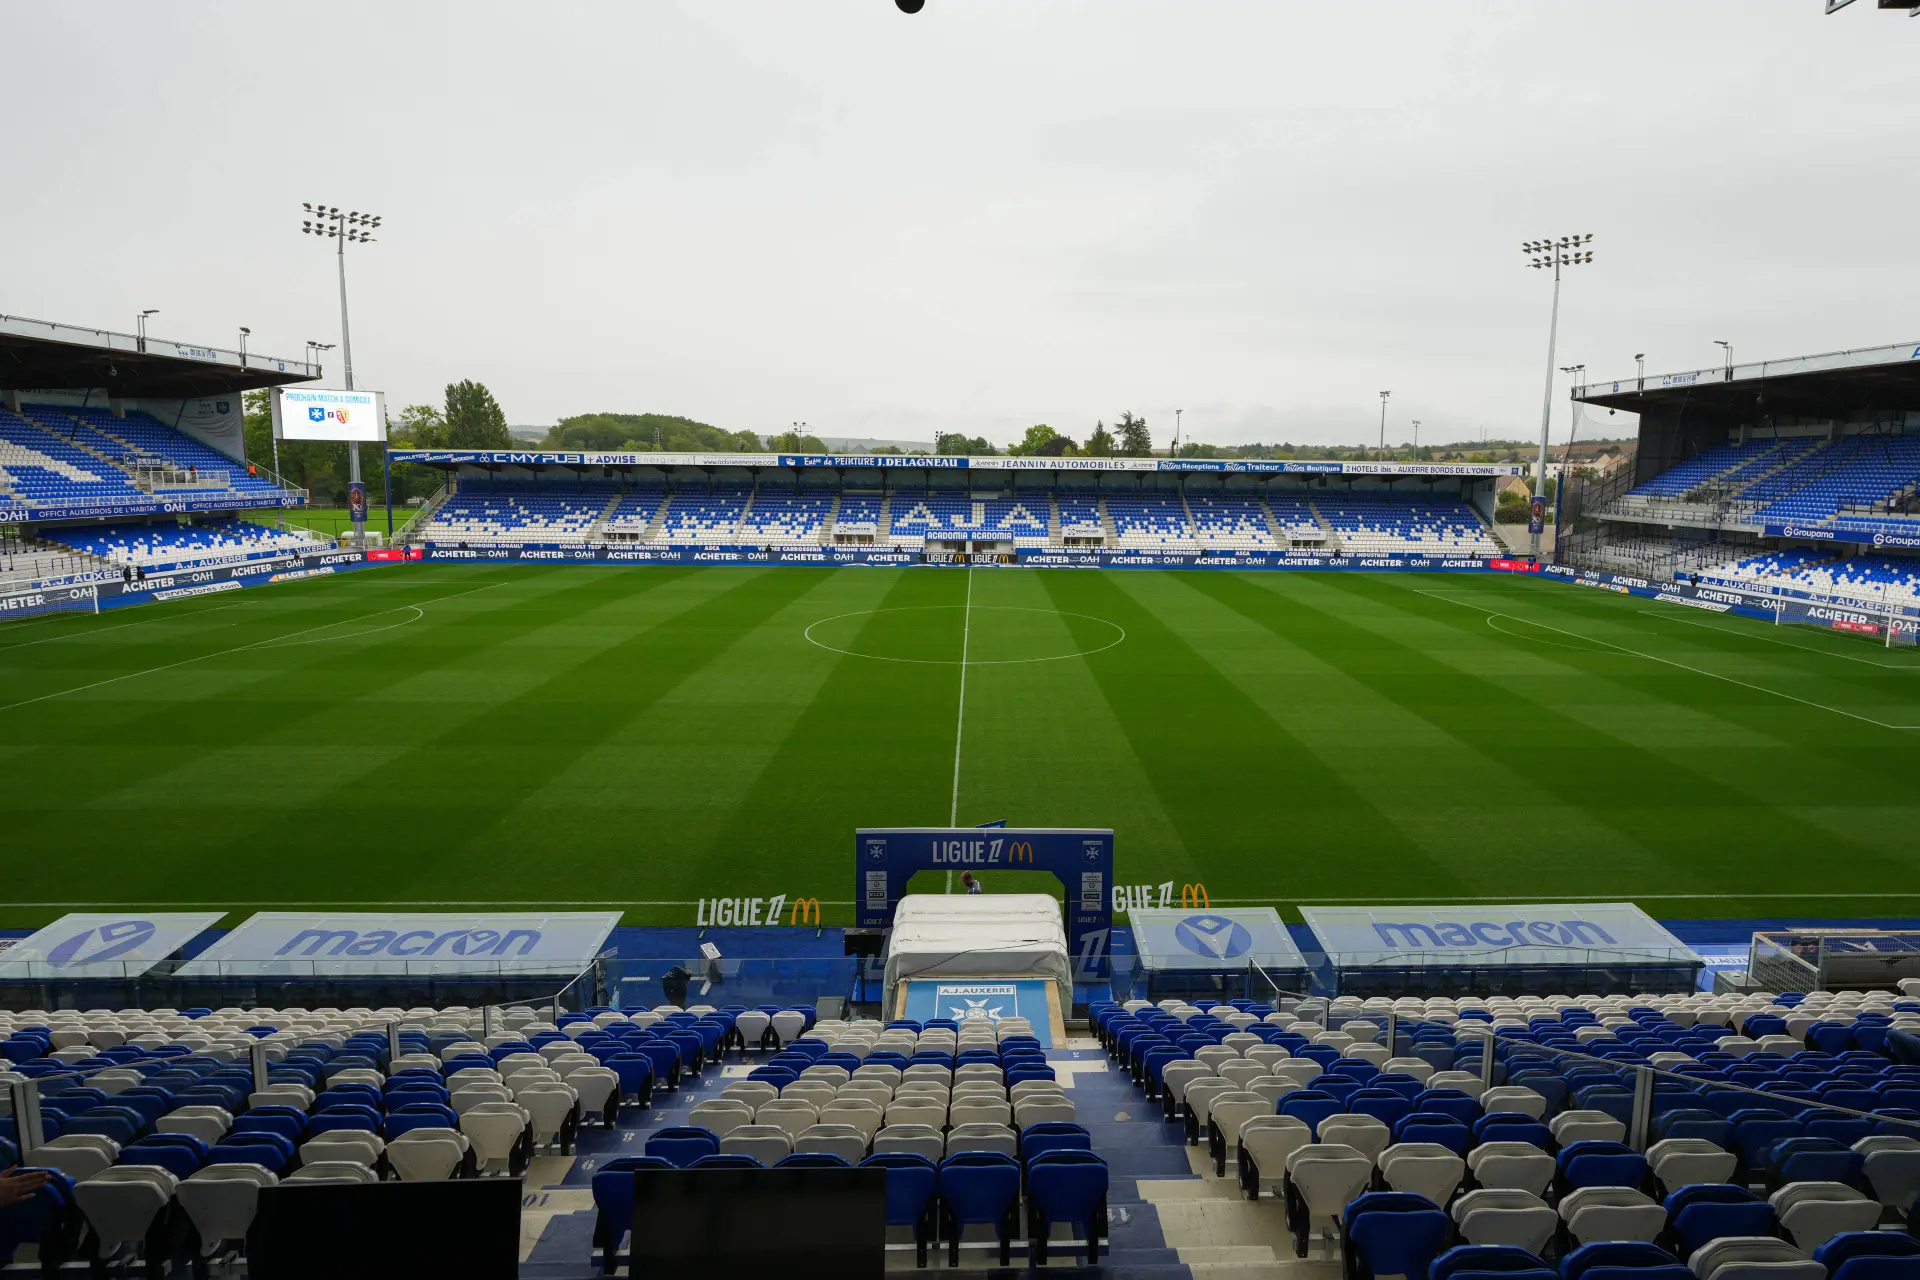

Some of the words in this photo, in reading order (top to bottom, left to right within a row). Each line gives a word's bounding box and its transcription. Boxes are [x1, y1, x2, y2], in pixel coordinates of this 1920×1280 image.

[286, 392, 316, 402] PROCHAIN
[318, 394, 338, 402] MATCH
[596, 456, 636, 464] ADVISE
[835, 458, 876, 466] PEINTURE
[1002, 460, 1046, 468] JEANNIN
[1050, 460, 1126, 469] AUTOMOBILES
[1246, 463, 1279, 471] Traiteur
[1306, 464, 1340, 473] Boutiques
[164, 502, 187, 512] OAH
[214, 500, 244, 508] AUXERROIS
[282, 497, 298, 506] OAH
[0, 510, 29, 522] OAH
[38, 510, 67, 518] OFFICE
[70, 508, 112, 516] AUXERROIS
[125, 506, 157, 514] L'HABITAT
[928, 532, 968, 540] ACADOMIA
[972, 532, 1012, 540] ACADOMIA
[1794, 528, 1834, 539] Groupama
[1885, 535, 1920, 546] Groupa
[275, 549, 293, 558] A.J.
[607, 552, 652, 560] ACHETER
[694, 552, 738, 560] ACHETER
[926, 554, 948, 562] LIGUE
[970, 554, 992, 562] LIGUE
[175, 562, 196, 570] A.J.
[200, 554, 248, 567] AUXERRE
[320, 554, 362, 565] ACHETER
[231, 564, 272, 578] ACHETER
[286, 558, 304, 568] OAH
[1545, 564, 1575, 576] ACHETER
[1584, 570, 1600, 580] OAH
[41, 577, 69, 588] A.J.
[122, 578, 175, 594] ACHETER
[192, 571, 214, 582] OAH
[1612, 576, 1648, 588] ACHETER
[1662, 583, 1680, 594] OAH
[1702, 576, 1720, 586] A.J.
[1722, 580, 1773, 594] AUXERRE
[1696, 590, 1742, 604] ACHETER
[1762, 599, 1786, 610] OAH
[1808, 606, 1868, 624] ACHETER
[932, 840, 986, 863] LIGUE
[697, 898, 763, 926] LIGUE
[1372, 920, 1618, 948] macron
[275, 928, 542, 956] macron
